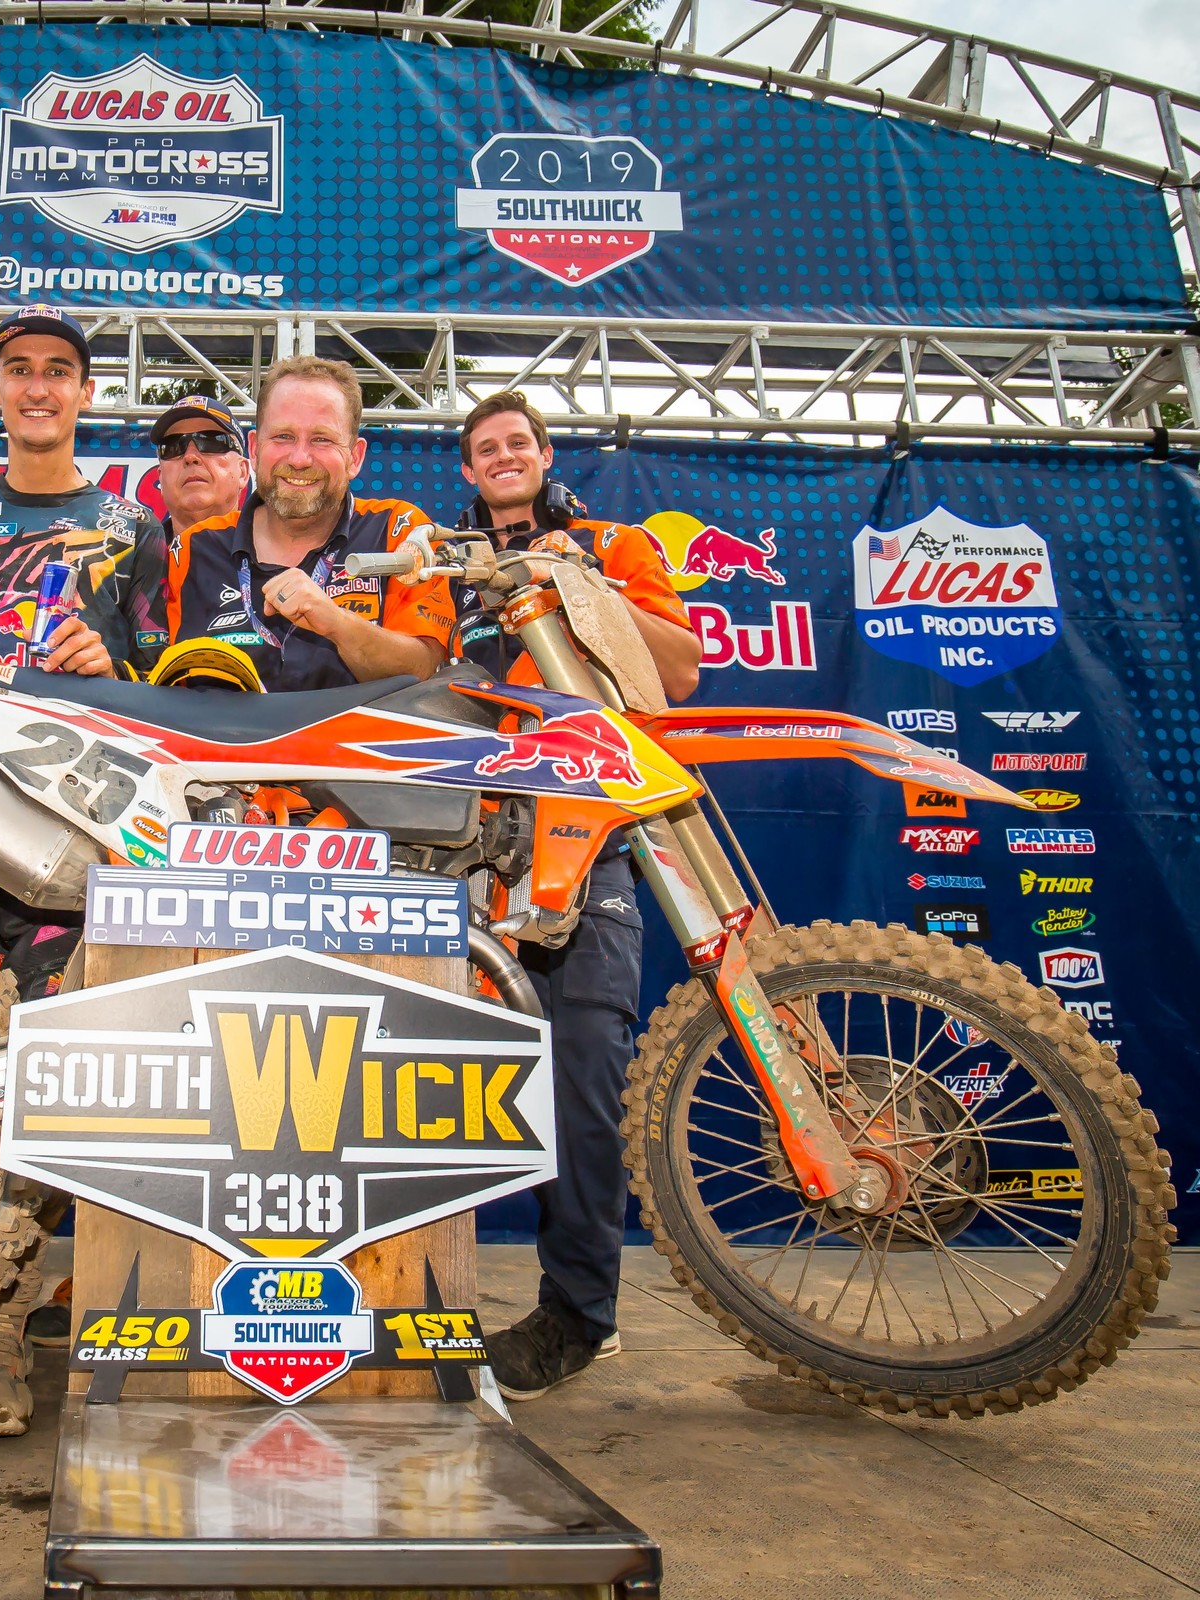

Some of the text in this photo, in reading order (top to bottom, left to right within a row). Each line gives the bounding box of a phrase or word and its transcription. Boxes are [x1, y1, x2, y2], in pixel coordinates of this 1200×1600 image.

[48, 90, 232, 122] LUCAS OIL
[108, 138, 173, 147] PRO
[11, 146, 269, 175] MOTOCROSS
[499, 149, 634, 183] 2019
[11, 170, 269, 186] CHAMPIONSHIP
[151, 212, 177, 221] PRO
[497, 198, 643, 222] SOUTHWICK
[510, 233, 634, 245] NATIONAL
[954, 546, 1044, 557] PERFORMANCE
[327, 578, 378, 597] Red Bull
[872, 561, 1042, 605] LUCAS
[864, 615, 1057, 638] OIL PRODUCTS
[683, 601, 818, 671] Bull
[940, 646, 994, 667] INC.
[887, 709, 957, 733] WPS
[744, 724, 841, 739] Red Bull
[915, 790, 958, 807] KTM
[135, 818, 154, 834] Twin
[549, 824, 591, 839] KTM
[902, 829, 940, 843] MX
[947, 829, 979, 842] ATV
[1007, 829, 1094, 844] PARTS
[179, 829, 310, 868] LUCAS
[317, 834, 378, 870] OIL
[915, 842, 965, 853] ALL OUT
[1009, 843, 1095, 853] UNLIMITED
[233, 874, 326, 891] PRO
[926, 876, 983, 888] SUZUKI
[1037, 877, 1093, 893] THOR
[93, 886, 460, 936] MOTOCROSS
[925, 911, 977, 922] GoPro
[1047, 907, 1087, 921] Battery
[1038, 919, 1083, 936] Tender
[92, 928, 461, 953] CHAMPIONSHIP
[1049, 957, 1095, 979] 100%
[649, 1042, 687, 1142] DUNLOP
[944, 1075, 1007, 1093] VERTEX
[224, 1174, 344, 1233] 338
[277, 1271, 325, 1298] MB
[79, 1316, 190, 1347] 450
[234, 1322, 342, 1343] SOUTHWICK
[384, 1313, 474, 1359] 1ST
[423, 1338, 484, 1348] PLACE
[78, 1347, 149, 1361] CLASS
[242, 1357, 334, 1366] NATIONAL
